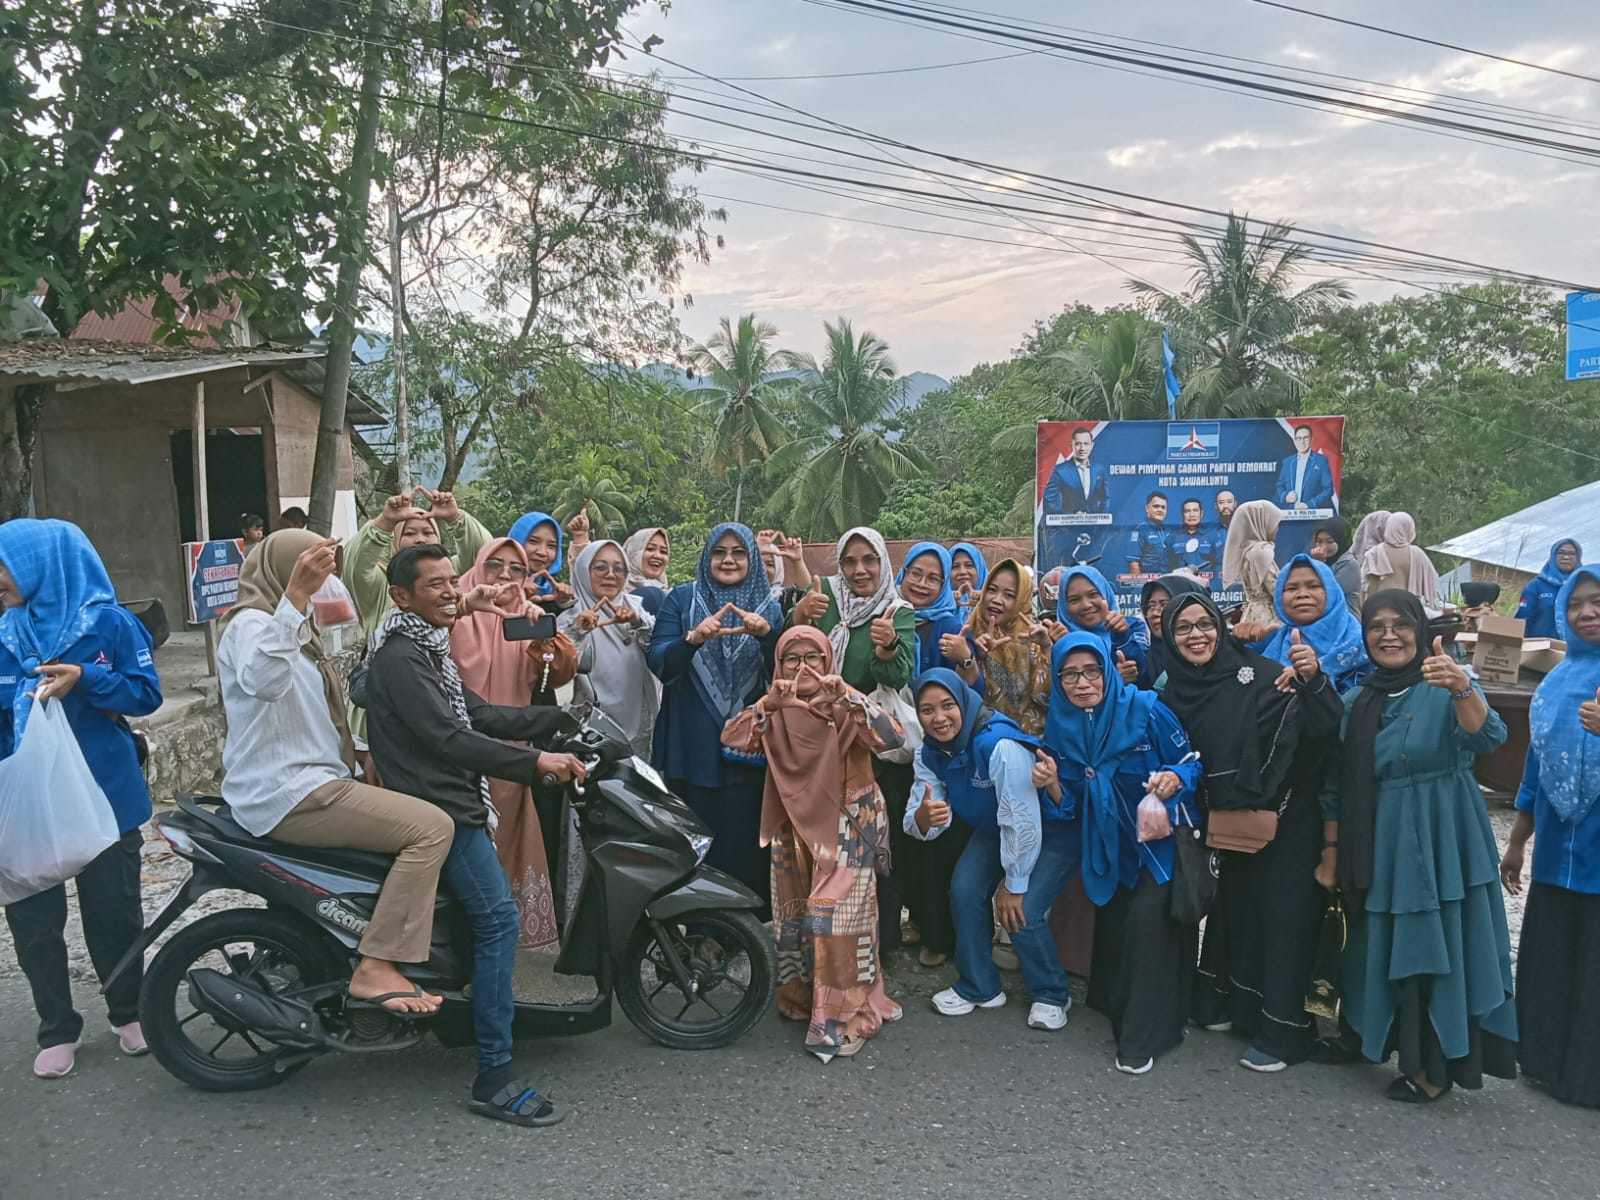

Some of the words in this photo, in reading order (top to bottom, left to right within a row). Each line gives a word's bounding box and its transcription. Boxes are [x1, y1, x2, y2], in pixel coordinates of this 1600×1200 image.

[1109, 464, 1136, 475] DEWAN
[1138, 463, 1176, 475] PIMPINAN
[1177, 463, 1208, 474] CABANG
[1209, 462, 1235, 473] PARTAI
[1237, 462, 1278, 473] DEMOKRAT
[1158, 477, 1178, 487] KOTA
[1180, 476, 1229, 487] SAWAHLUNTO
